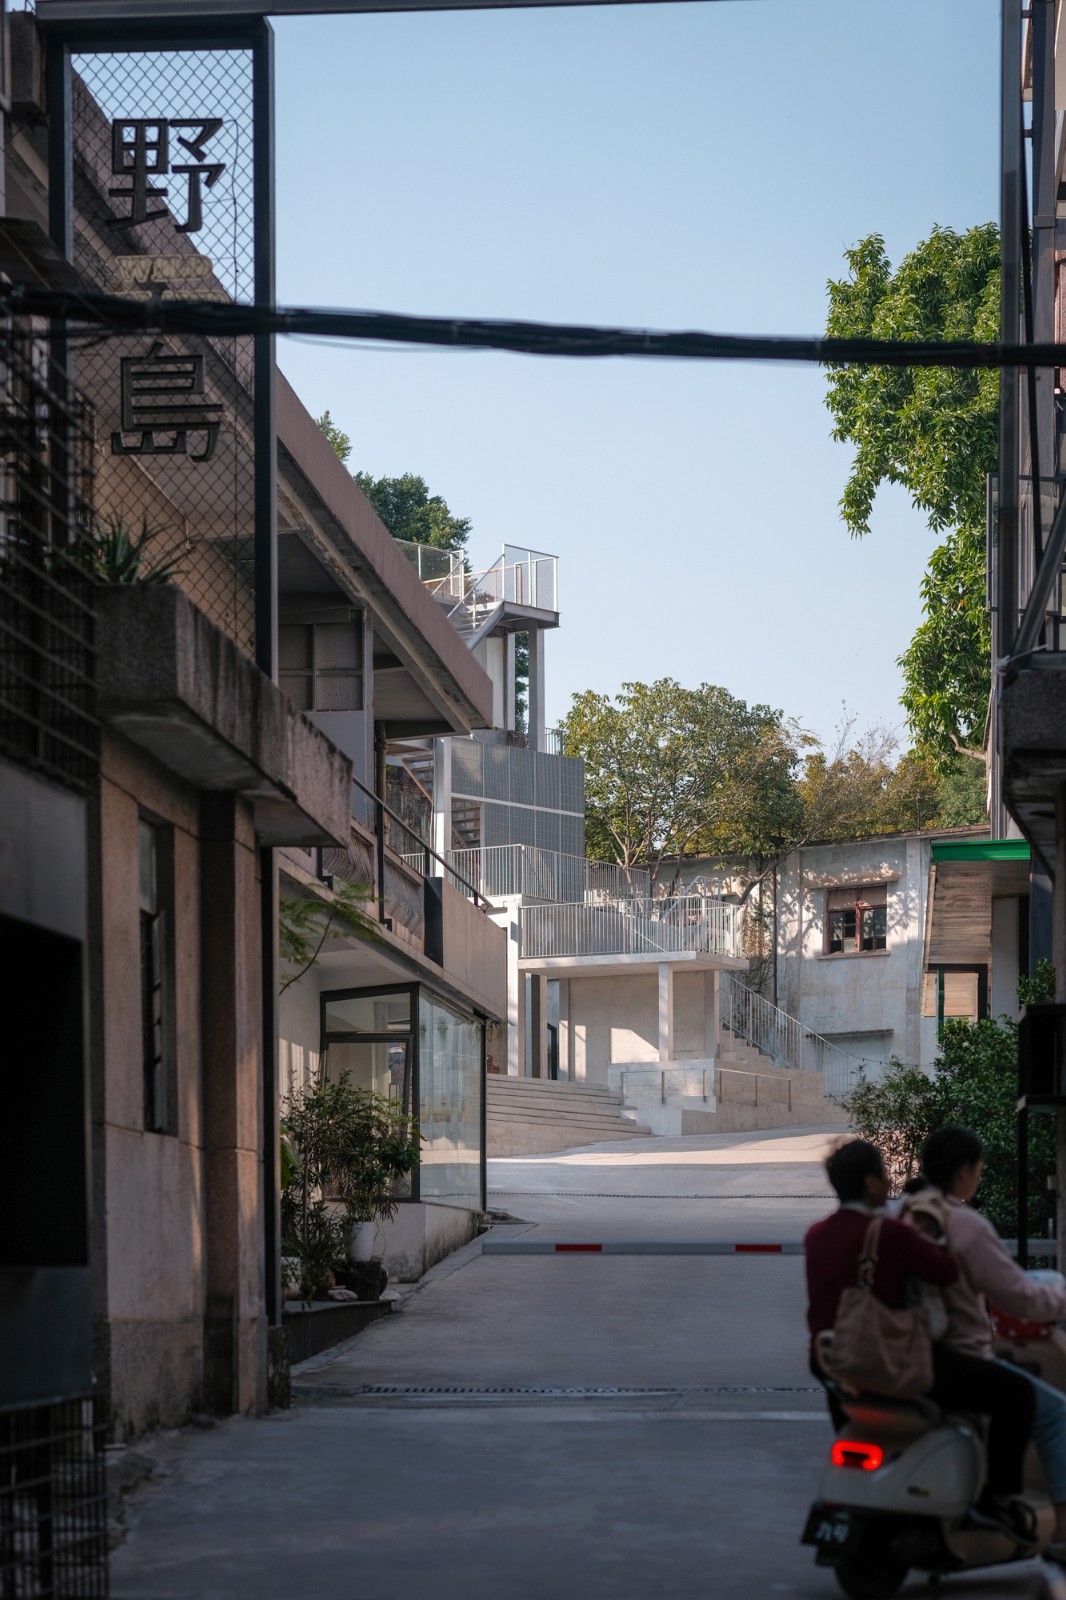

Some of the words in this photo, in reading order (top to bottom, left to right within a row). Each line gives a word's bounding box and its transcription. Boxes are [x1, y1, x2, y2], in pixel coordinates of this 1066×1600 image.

[106, 118, 226, 233] 野
[115, 254, 213, 283] WILD
[111, 338, 223, 463] 島
